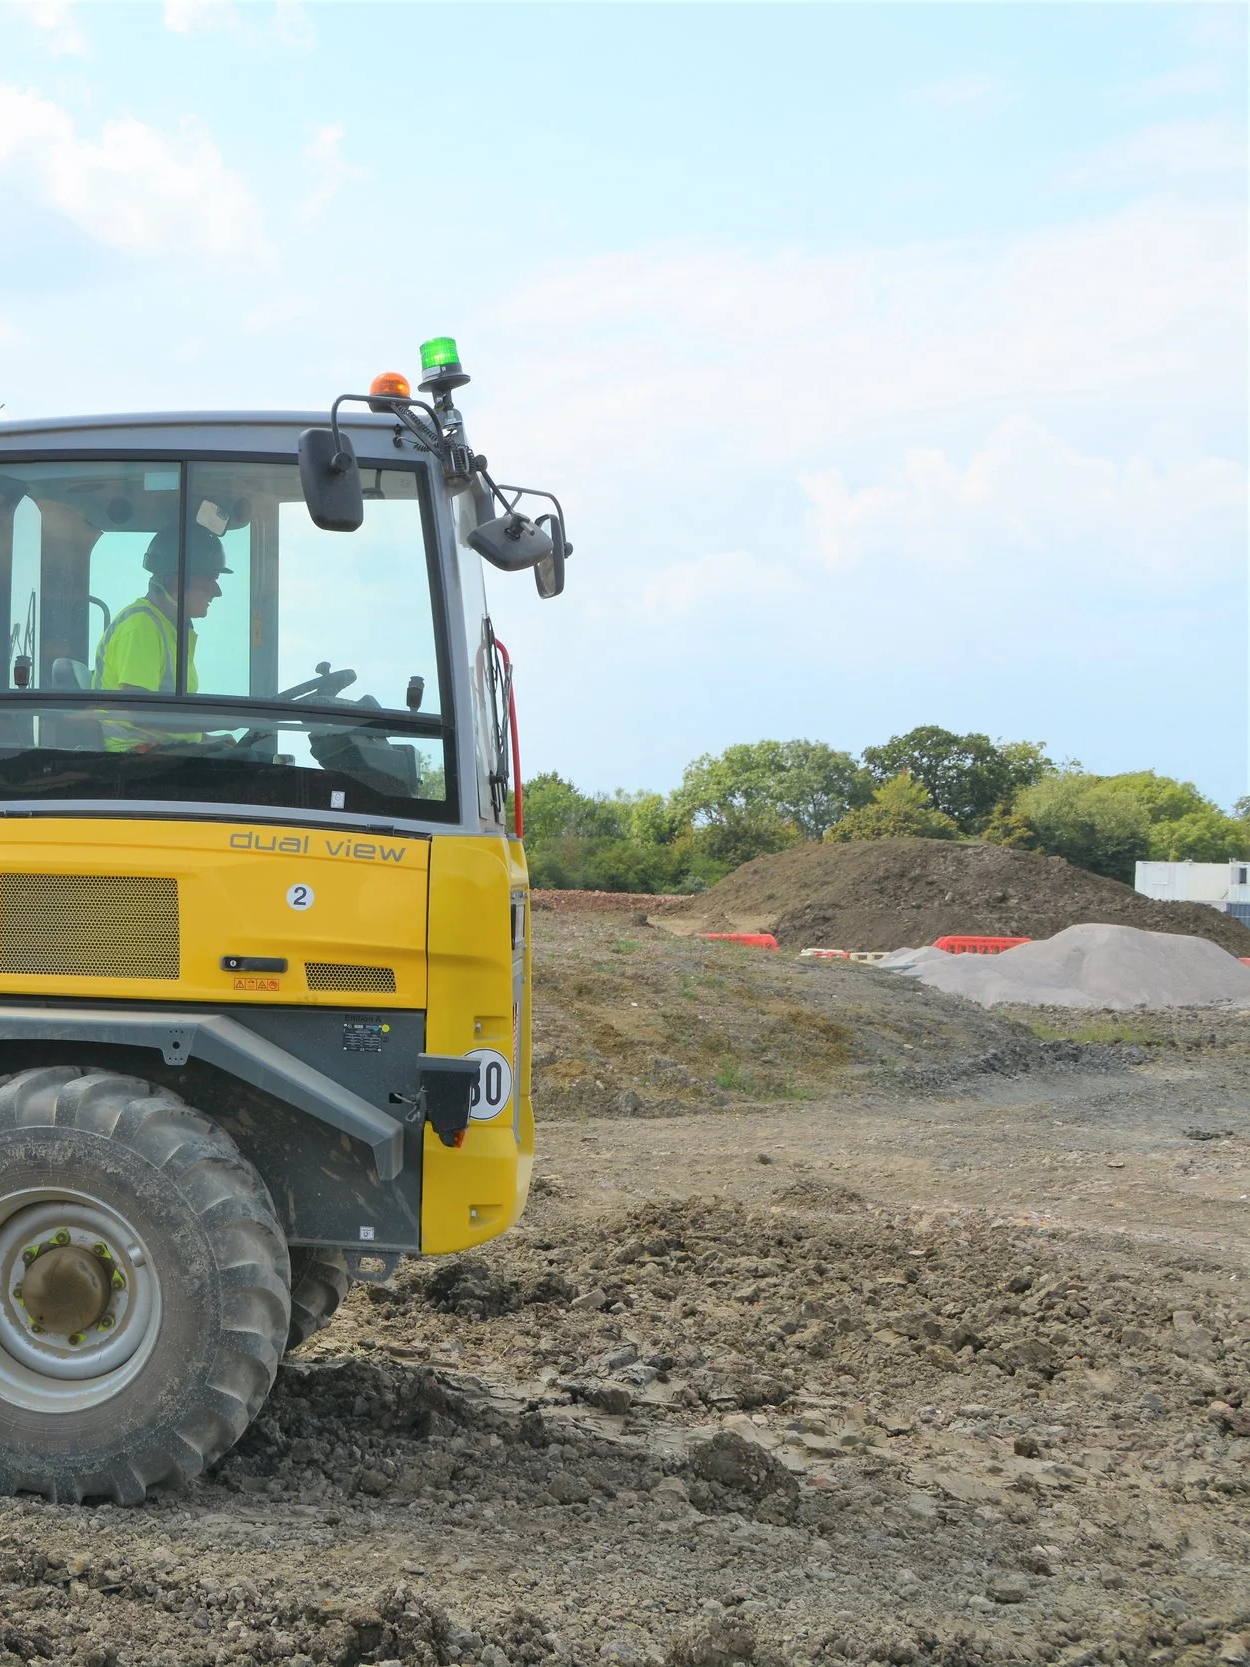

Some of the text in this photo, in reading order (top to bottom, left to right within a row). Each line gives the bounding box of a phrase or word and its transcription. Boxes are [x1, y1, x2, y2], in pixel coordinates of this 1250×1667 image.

[229, 832, 406, 862] dual view
[293, 886, 307, 906] 2
